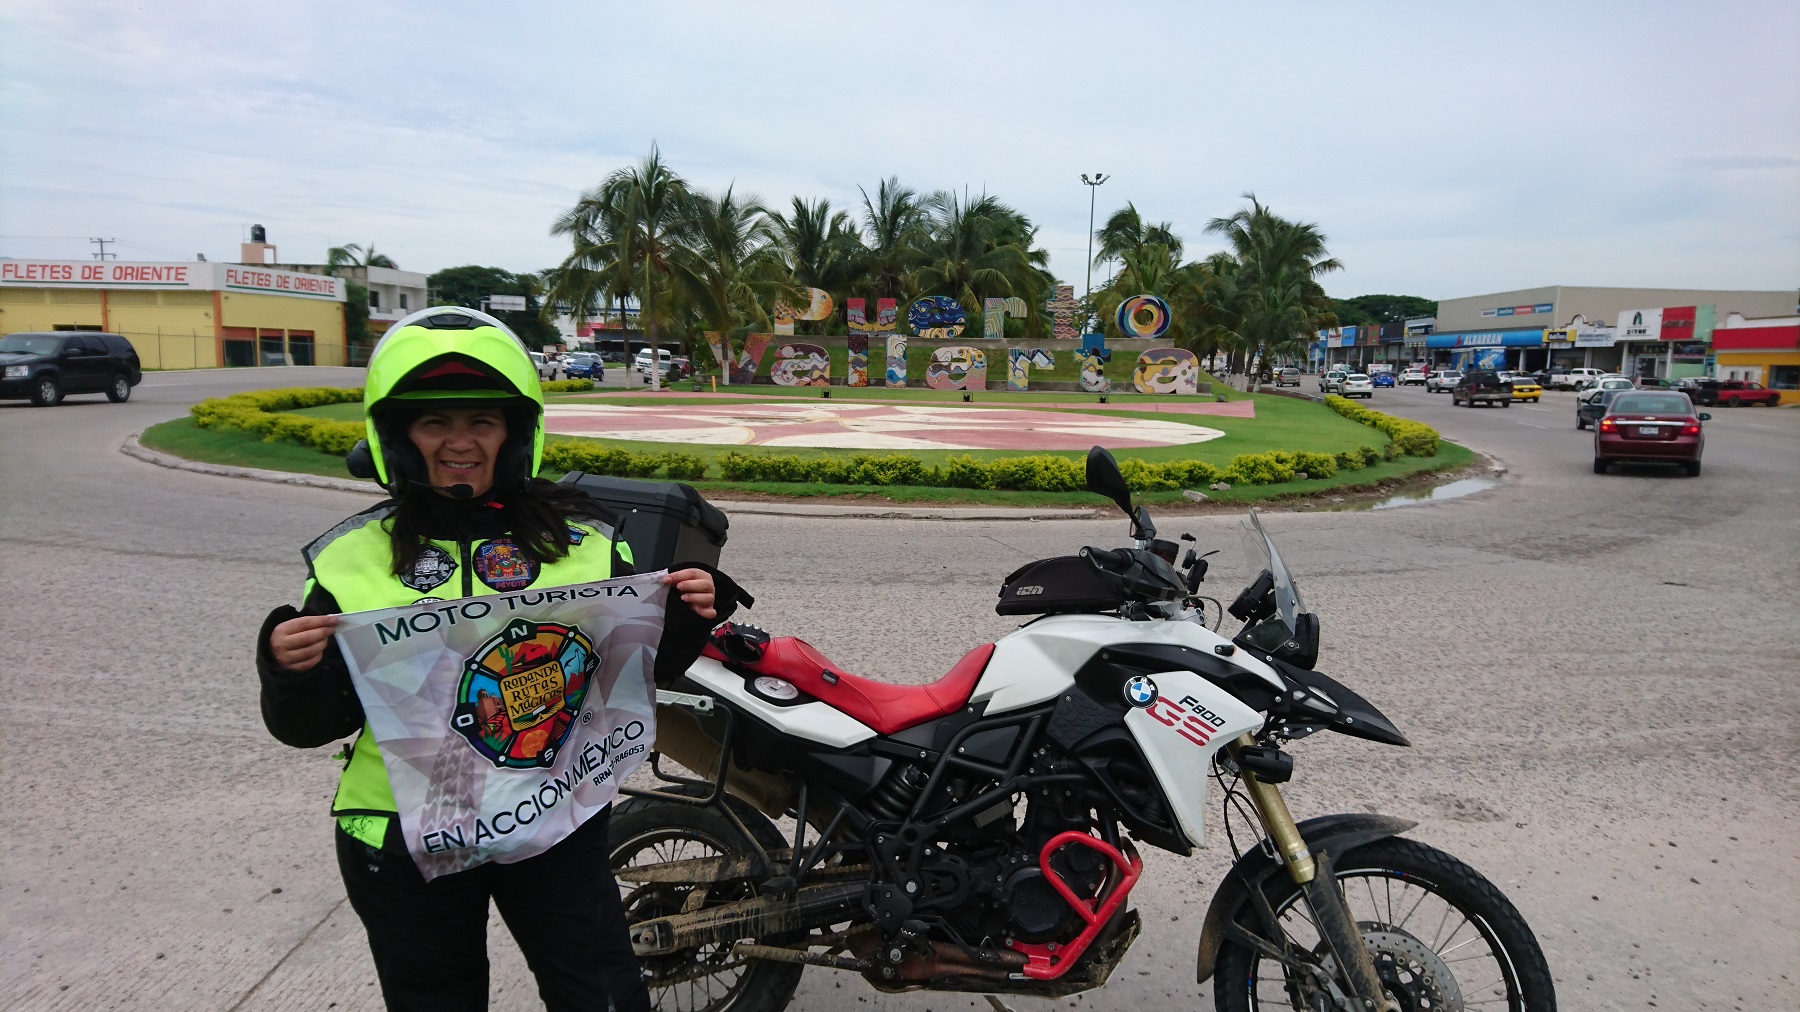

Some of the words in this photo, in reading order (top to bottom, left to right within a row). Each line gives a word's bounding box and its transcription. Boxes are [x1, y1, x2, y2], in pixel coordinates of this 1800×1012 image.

[2, 263, 73, 280] FLETES
[81, 265, 105, 280] DE
[112, 266, 189, 282] ORIENTE
[226, 269, 273, 288] FLETES
[275, 275, 290, 289] DE
[293, 277, 336, 294] ORIENTE
[774, 285, 1173, 338] Puerto
[1463, 333, 1503, 346] ALBARRAN
[704, 331, 1199, 394] Vallarta
[374, 601, 492, 645] MOTO
[500, 585, 639, 610] TURISTA
[510, 624, 528, 639] N
[456, 713, 474, 727] O
[1145, 695, 1218, 747] GS
[1178, 695, 1226, 727] F800
[543, 747, 554, 762] S
[422, 825, 466, 853] EN
[475, 771, 572, 845] ACCIÓN
[572, 720, 644, 785] MÉXICO
